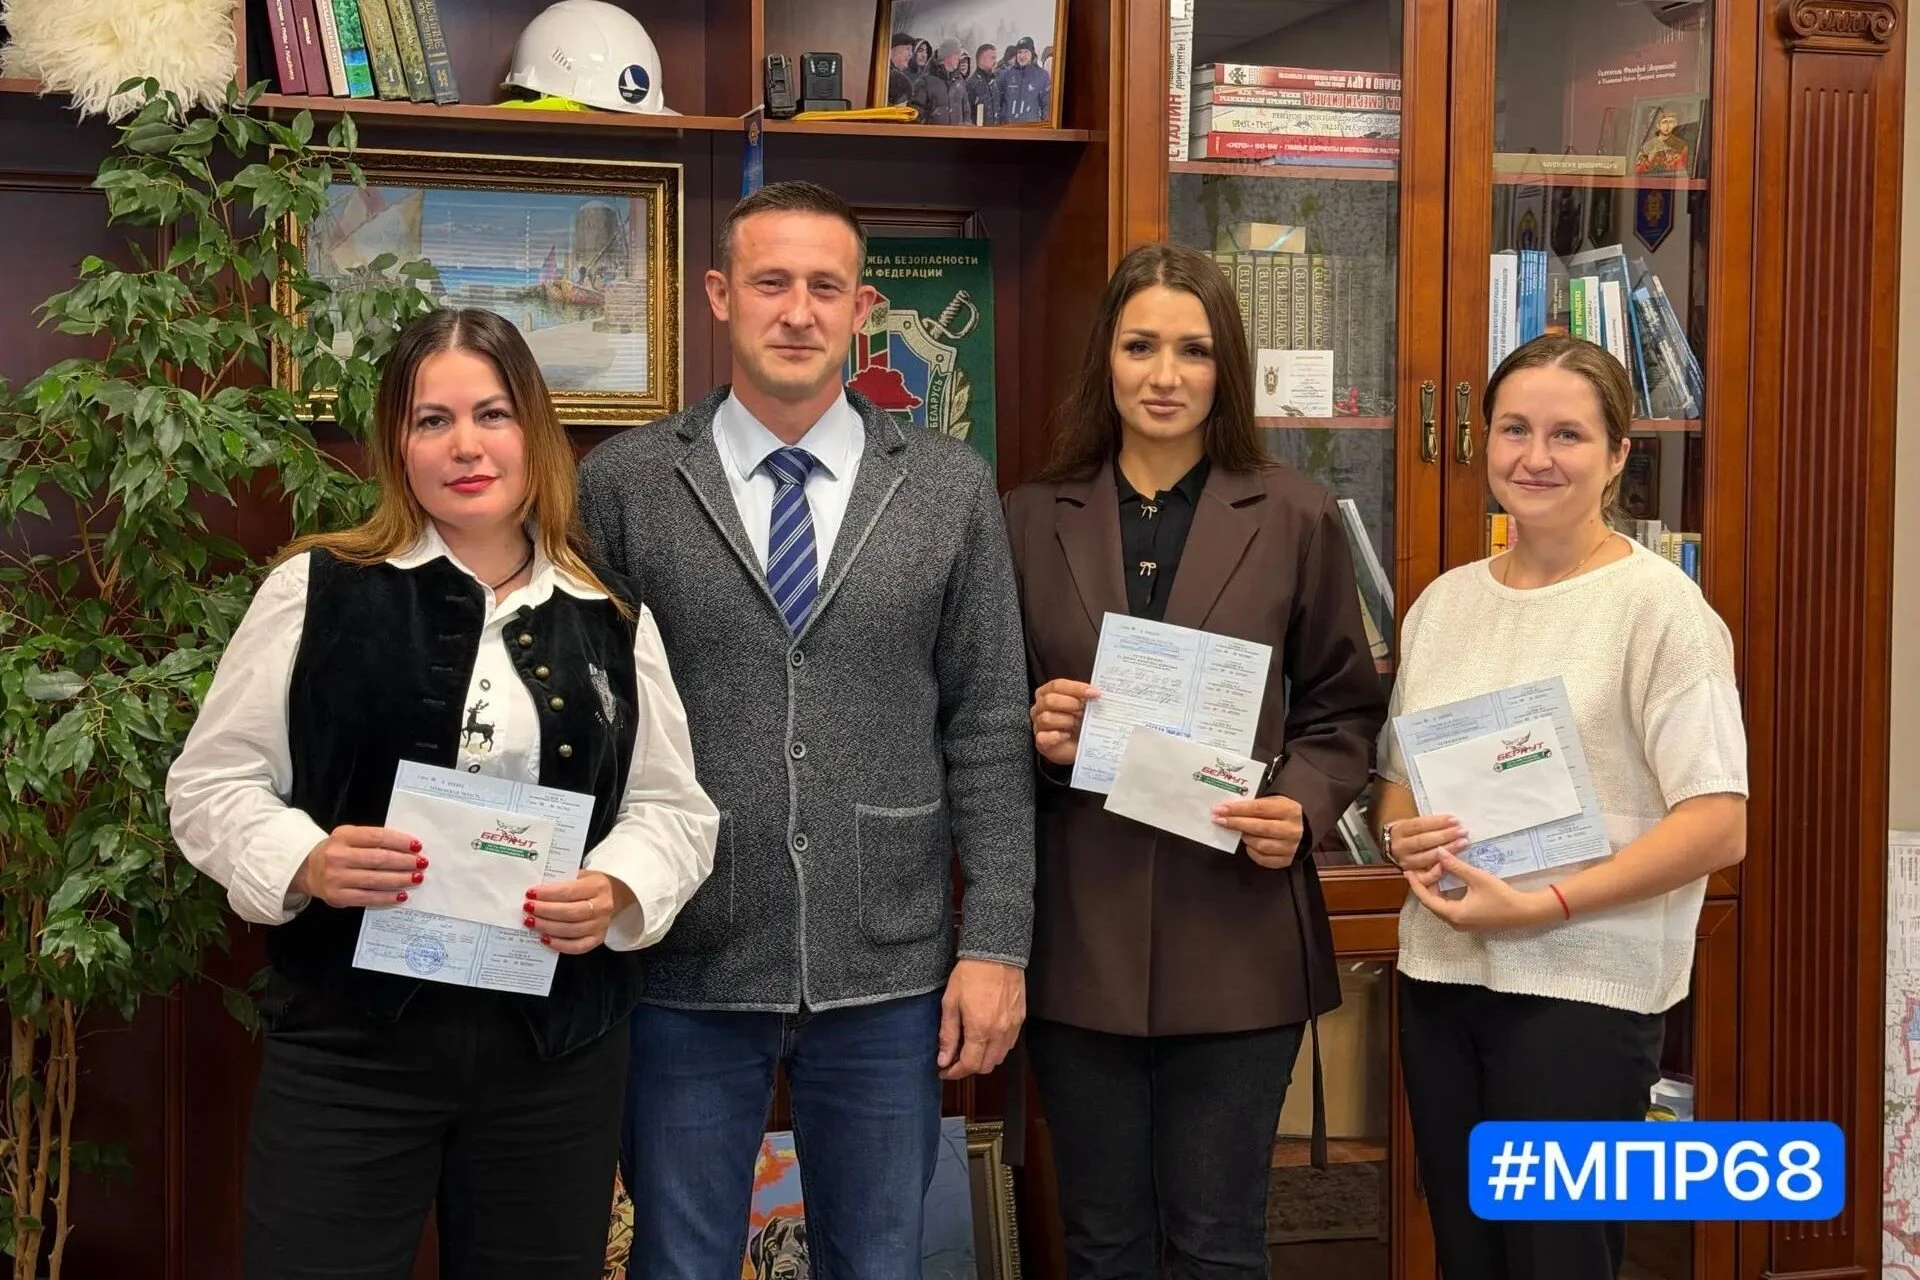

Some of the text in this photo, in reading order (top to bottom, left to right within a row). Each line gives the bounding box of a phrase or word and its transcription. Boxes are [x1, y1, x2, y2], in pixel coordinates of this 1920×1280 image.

[388, 67, 395, 82] 1
[414, 71, 425, 85] 2
[1302, 91, 1344, 108] ГИТЛЕРА
[1345, 94, 1385, 109] СМЕРТИ
[867, 255, 978, 265] ЖБА БЕЗОПАСНОСТИ
[875, 268, 943, 278] ФЕДЕРАЦИИ
[929, 379, 943, 428] БЕЛАРУСЬ
